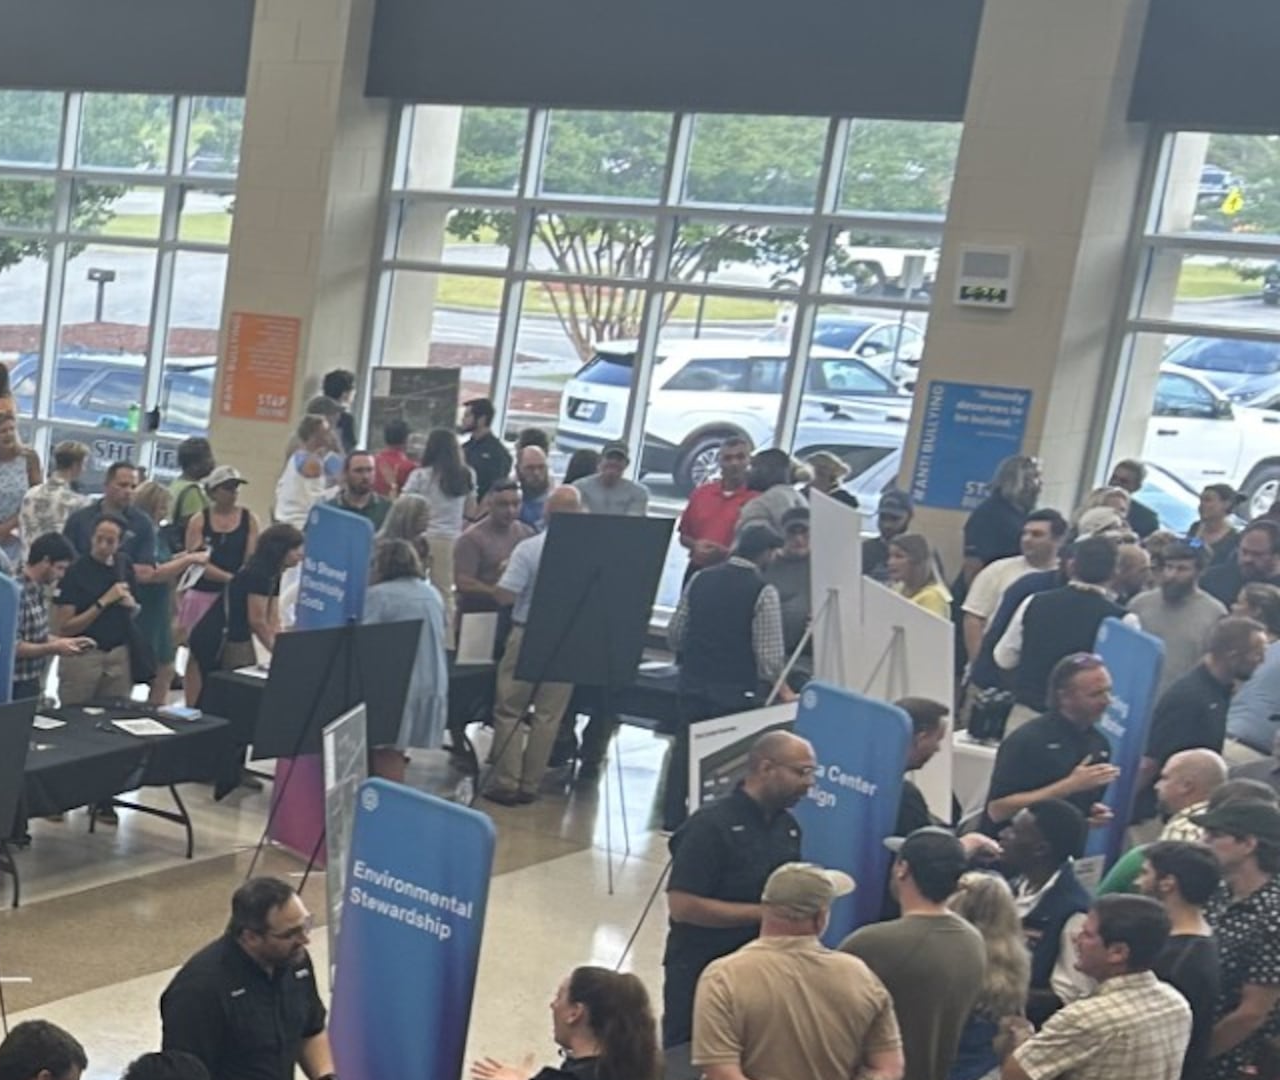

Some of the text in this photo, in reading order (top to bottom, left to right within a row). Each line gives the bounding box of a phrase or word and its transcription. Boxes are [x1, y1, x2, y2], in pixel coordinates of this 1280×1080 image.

[921, 384, 945, 453] BULLYING
[827, 765, 878, 797] Center
[350, 886, 452, 941] Stewardship
[353, 859, 473, 918] Environmental
